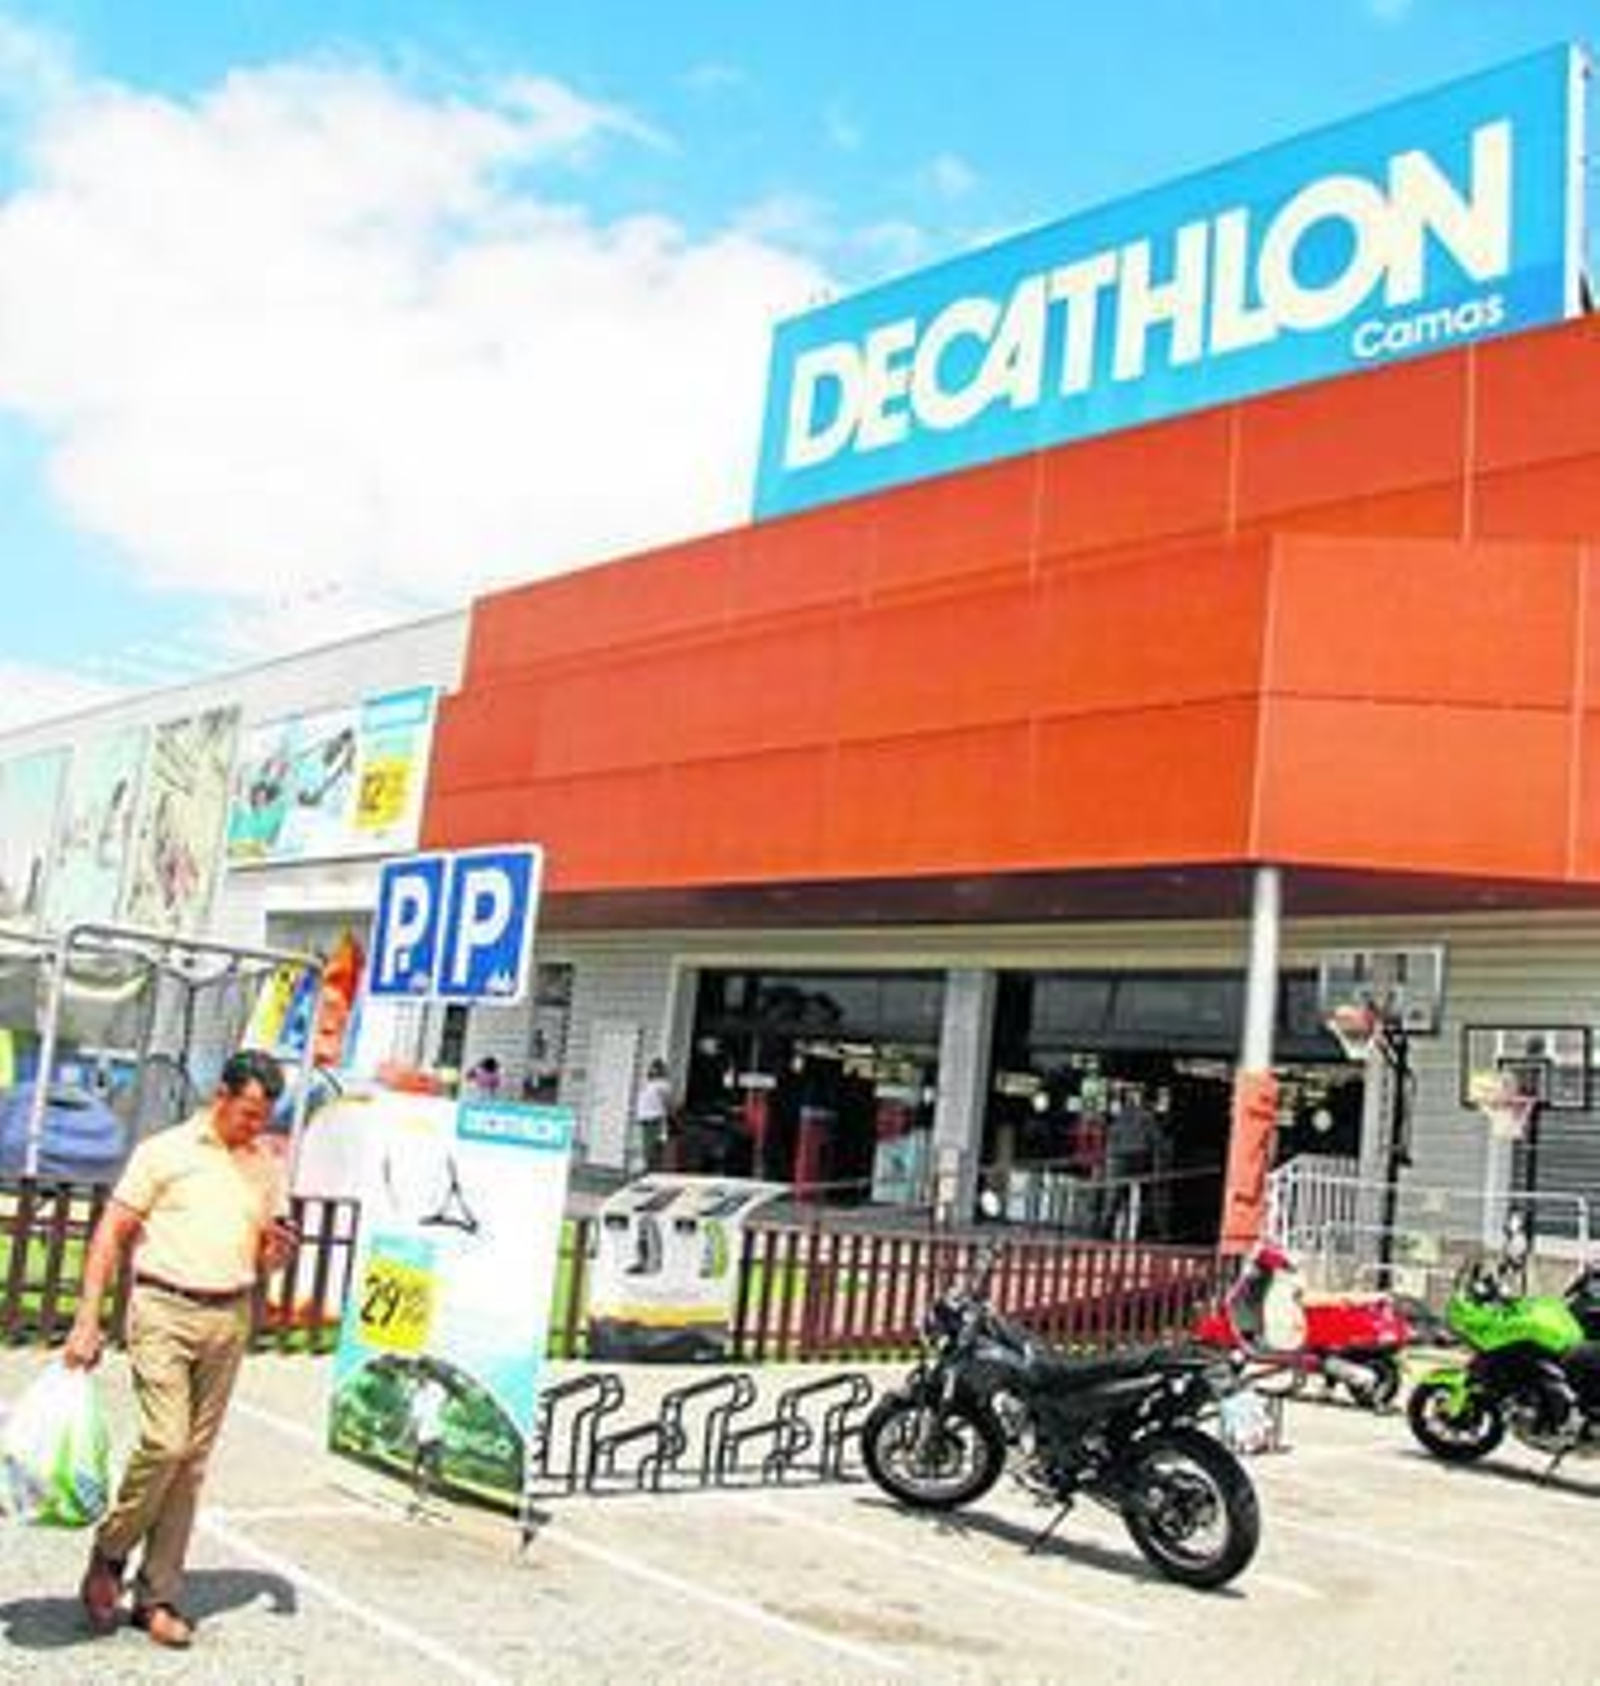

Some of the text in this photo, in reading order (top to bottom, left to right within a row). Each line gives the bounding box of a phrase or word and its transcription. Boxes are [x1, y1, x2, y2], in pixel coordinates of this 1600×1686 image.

[782, 119, 1513, 472] DECATHLON
[1353, 294, 1504, 359] Camas
[380, 875, 430, 985] P
[452, 867, 513, 985] P
